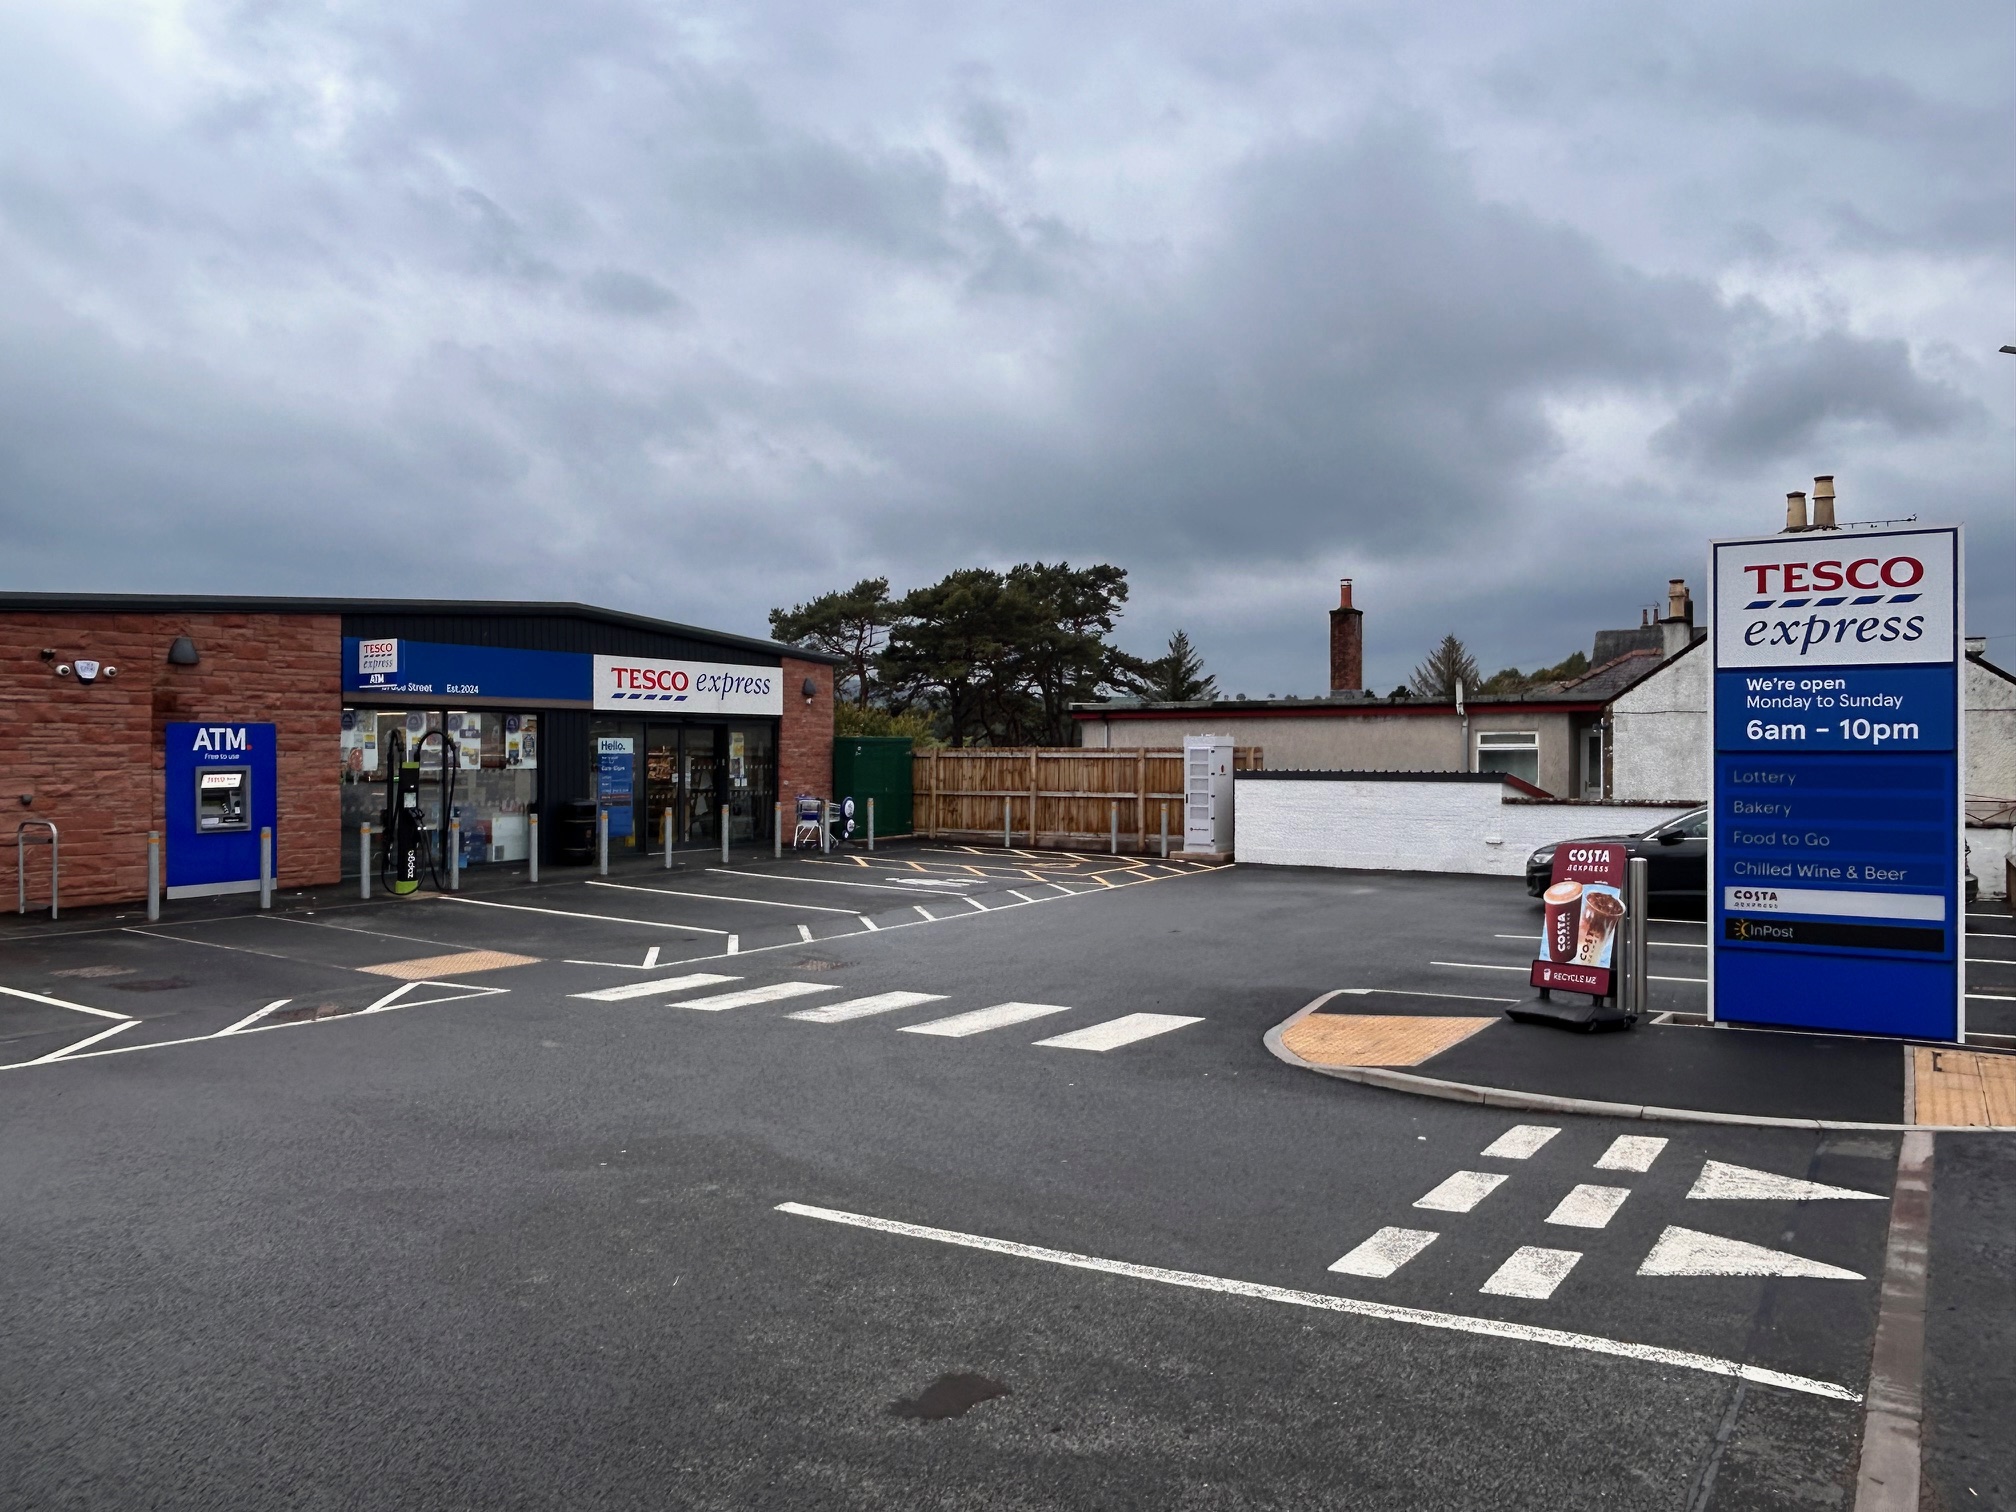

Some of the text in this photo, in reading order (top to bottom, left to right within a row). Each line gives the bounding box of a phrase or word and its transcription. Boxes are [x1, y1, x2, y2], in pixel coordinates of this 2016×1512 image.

[1743, 556, 1924, 594] TESCO
[1744, 613, 1925, 655] express
[363, 643, 393, 654] TESCO
[363, 660, 393, 671] express
[407, 682, 433, 692] Street
[611, 667, 771, 701] TESCO express
[1800, 678, 1846, 693] open
[1746, 692, 1904, 711] Monday to Sunday
[1746, 719, 1807, 740] 6am
[1839, 718, 1919, 746] 10pm
[1733, 770, 1797, 786] Lottery
[1733, 800, 1792, 818] Bakery
[1733, 830, 1830, 847] Food to Go
[1568, 849, 1610, 863] COSTA
[1733, 861, 1908, 881] Chilled Wine & Beer
[1734, 890, 1778, 901] COSTA
[1557, 913, 1566, 952] COSTA
[1750, 924, 1793, 938] InPost
